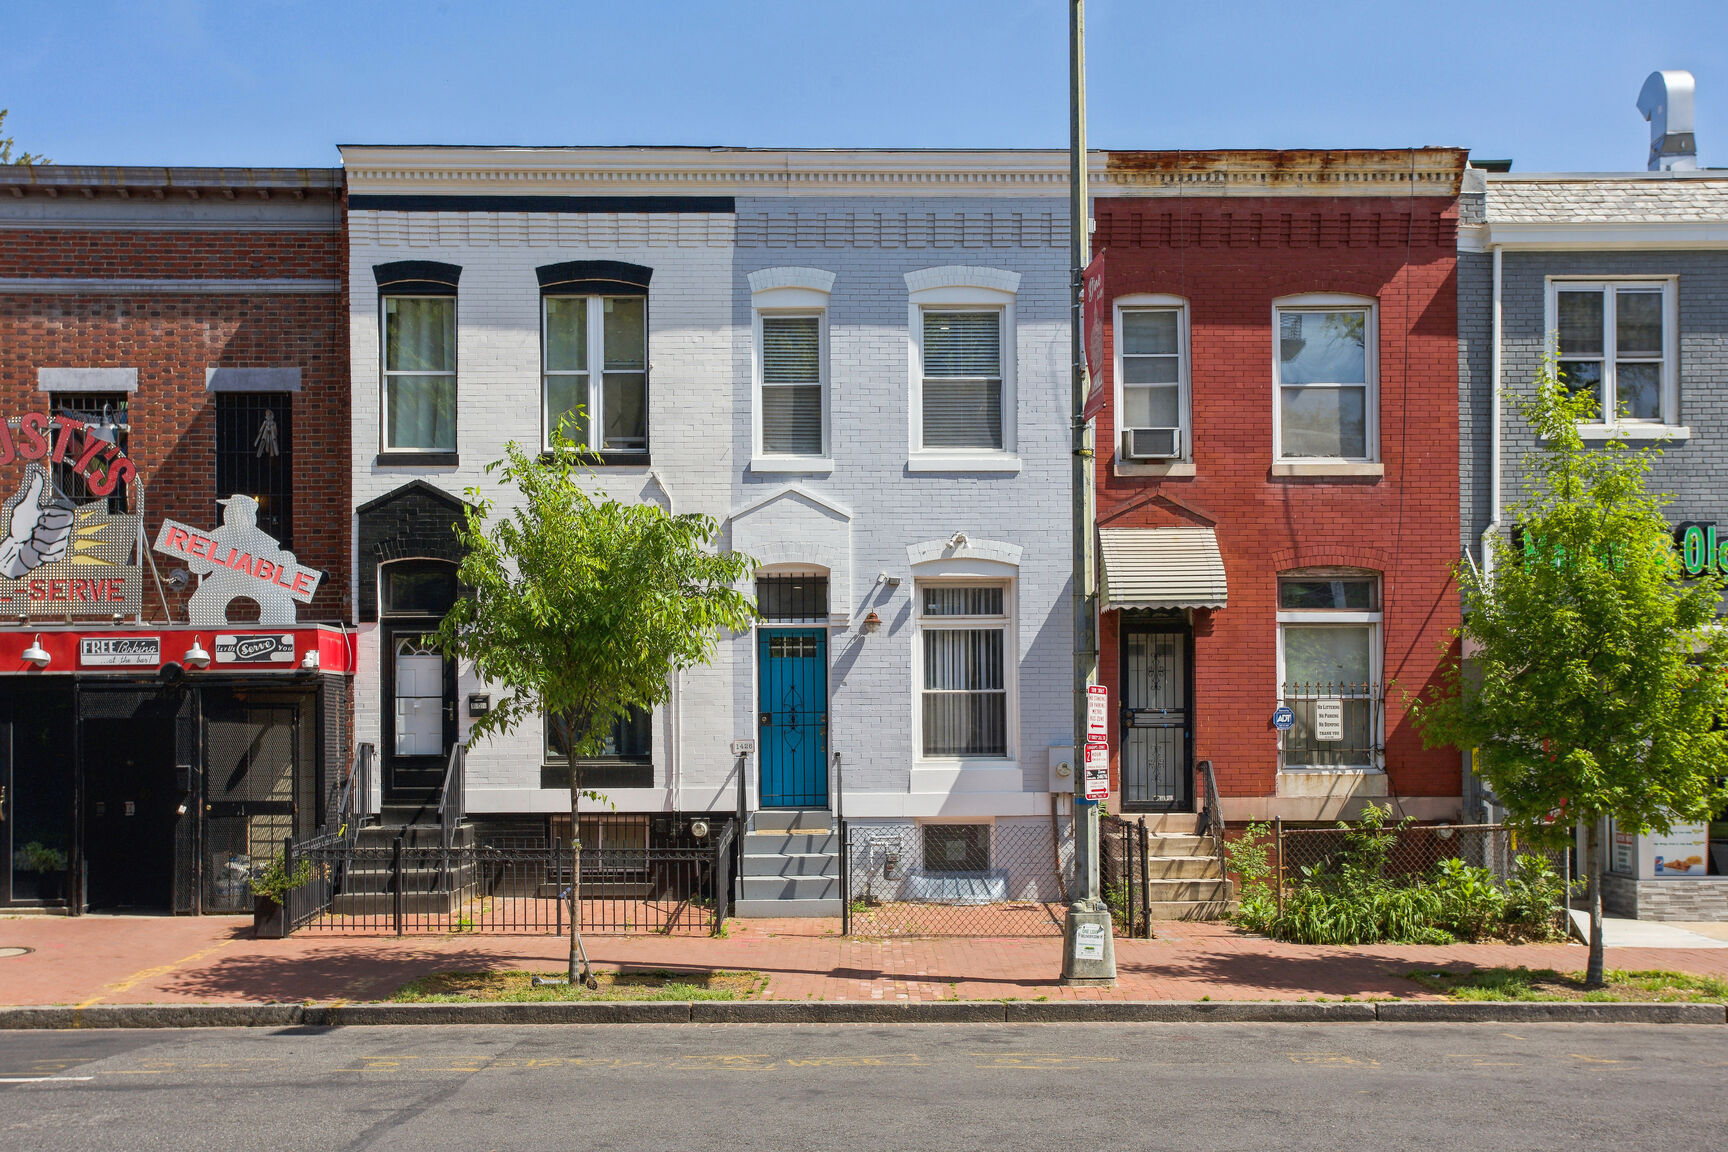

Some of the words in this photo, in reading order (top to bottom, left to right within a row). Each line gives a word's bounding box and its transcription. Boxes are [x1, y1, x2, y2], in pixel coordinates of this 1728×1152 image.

[164, 525, 316, 596] RELIABLE
[0, 579, 125, 602] -SERVE
[83, 640, 117, 654] FREE
[117, 640, 157, 655] Parking
[241, 640, 272, 655] Serve
[1277, 714, 1291, 723] ADT
[1087, 751, 1090, 762] 2
